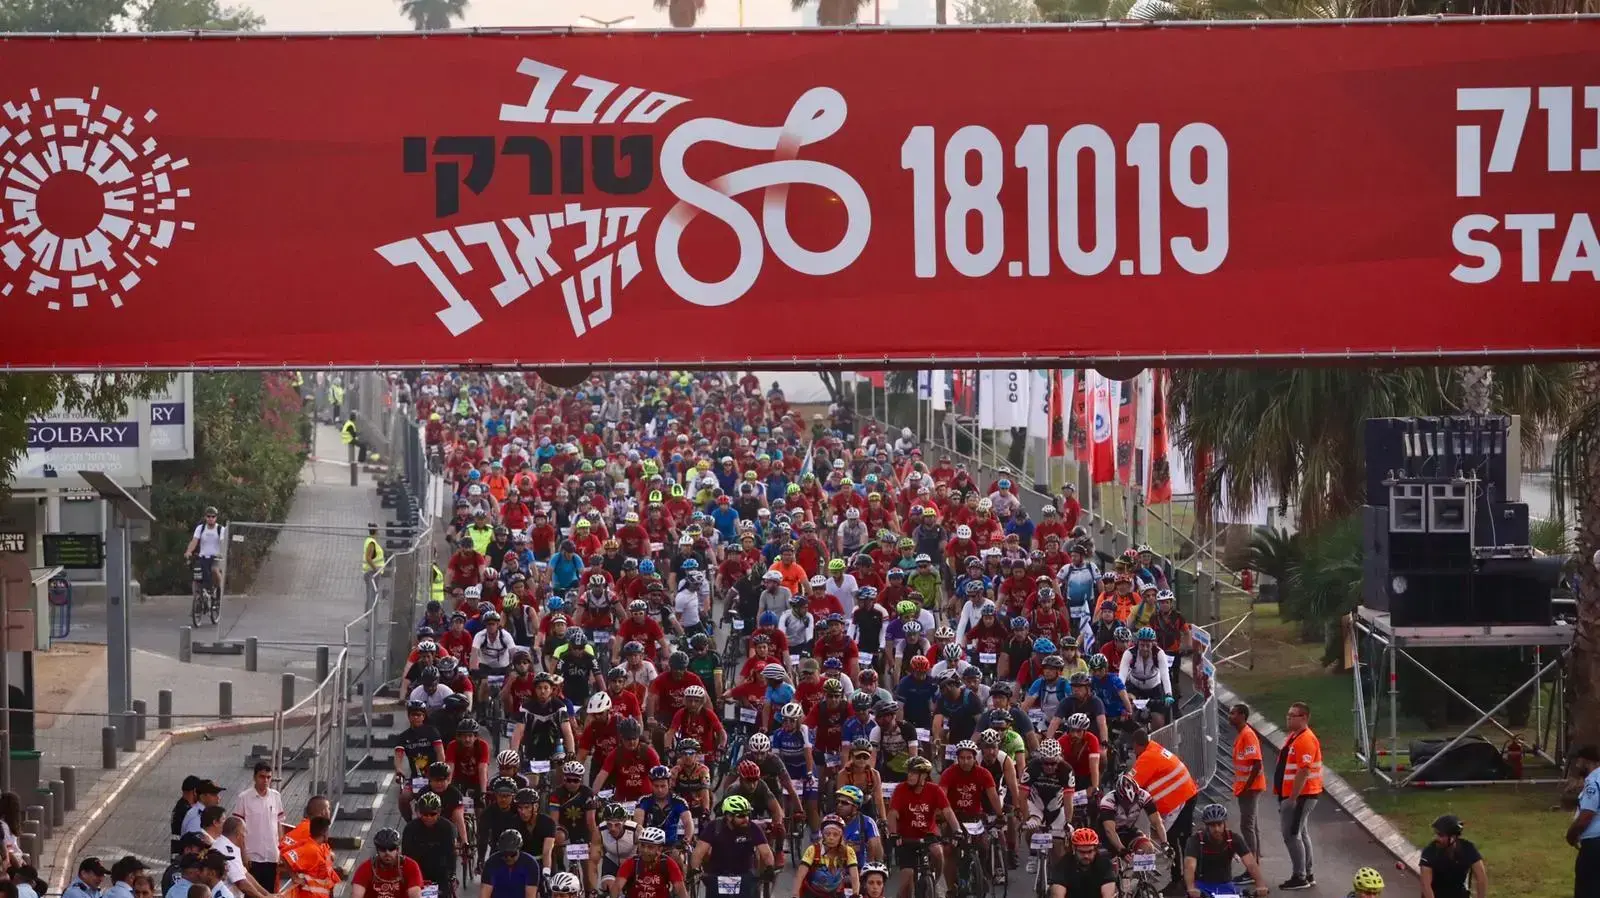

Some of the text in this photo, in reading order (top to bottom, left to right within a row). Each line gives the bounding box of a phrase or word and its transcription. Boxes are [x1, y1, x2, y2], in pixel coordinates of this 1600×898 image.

[499, 57, 693, 124] סובב
[403, 134, 653, 218] טורקי
[901, 122, 1229, 278] 18.10.19
[1450, 213, 1600, 284] STA
[28, 427, 128, 443] GOLBARY
[152, 407, 175, 421] RY
